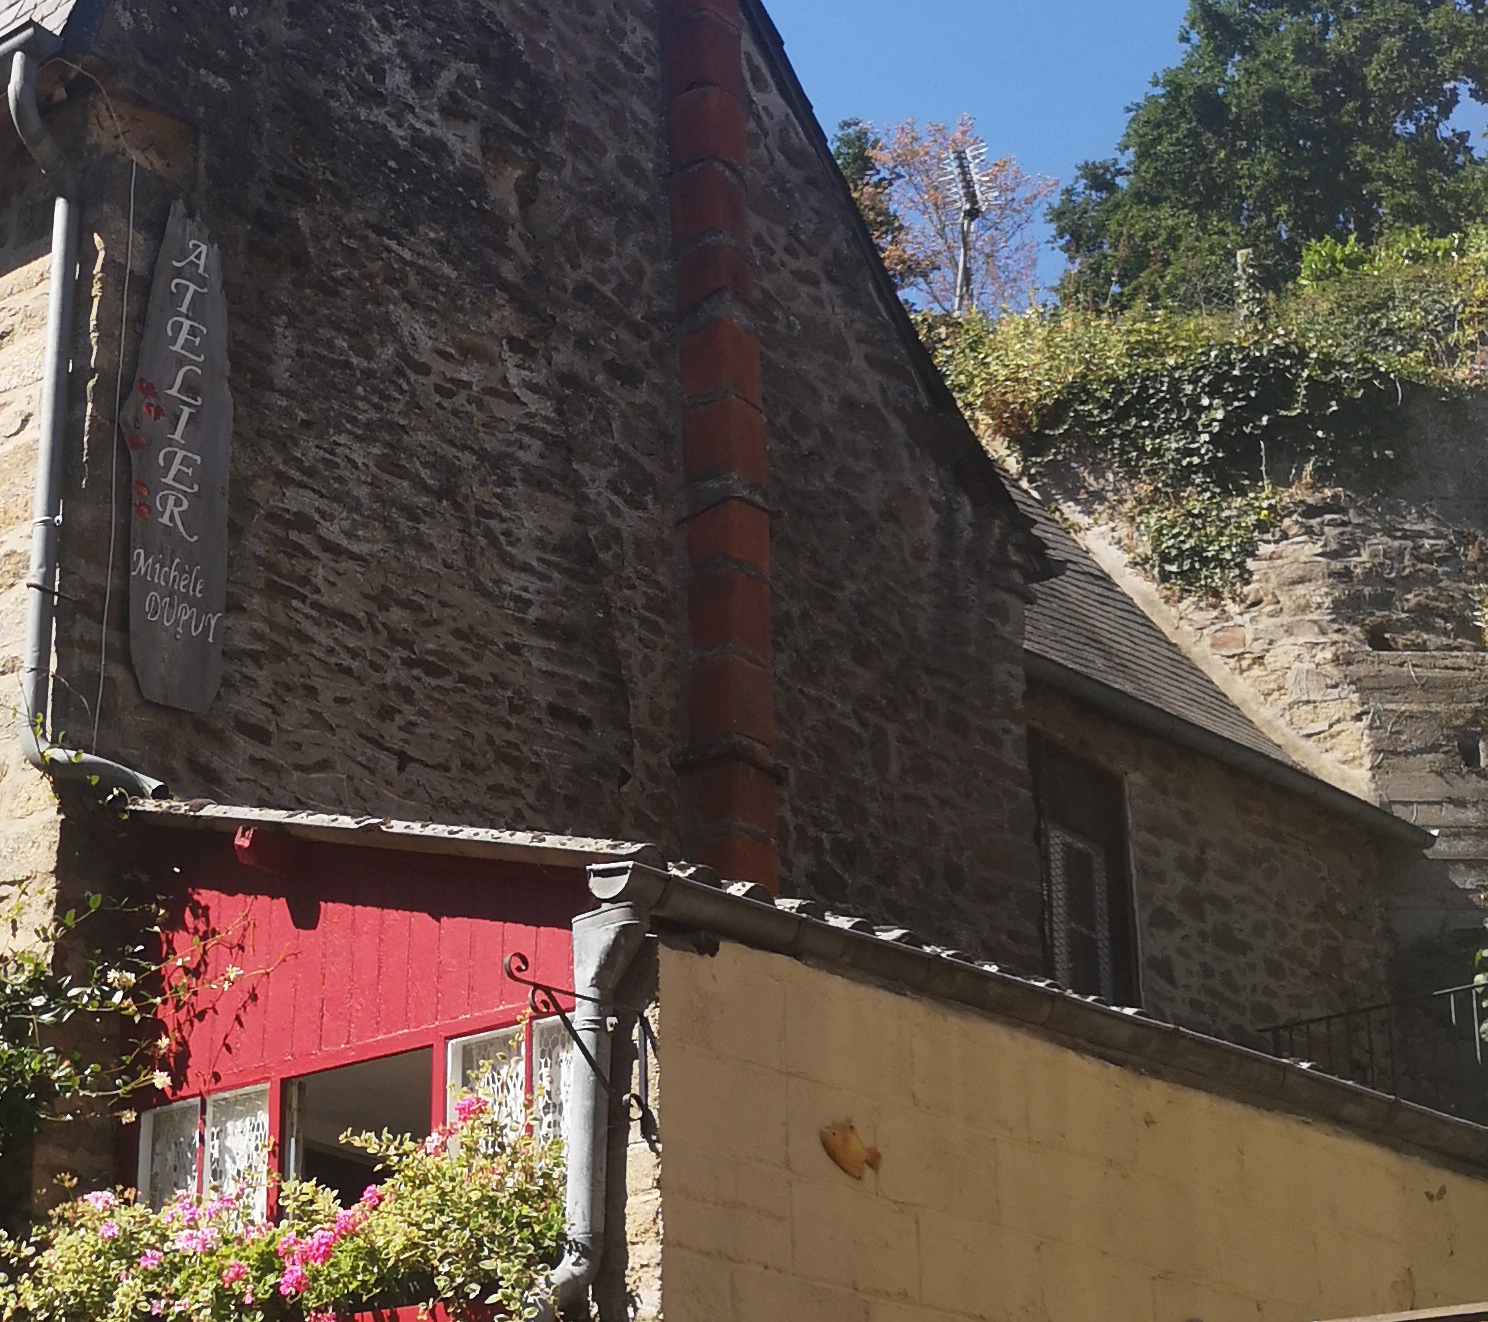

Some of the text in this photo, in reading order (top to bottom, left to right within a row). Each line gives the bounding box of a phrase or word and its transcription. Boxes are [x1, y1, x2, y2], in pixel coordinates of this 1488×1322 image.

[156, 239, 210, 543] ATELIER
[130, 548, 206, 598] Michèle
[144, 593, 223, 644] DUPUY
